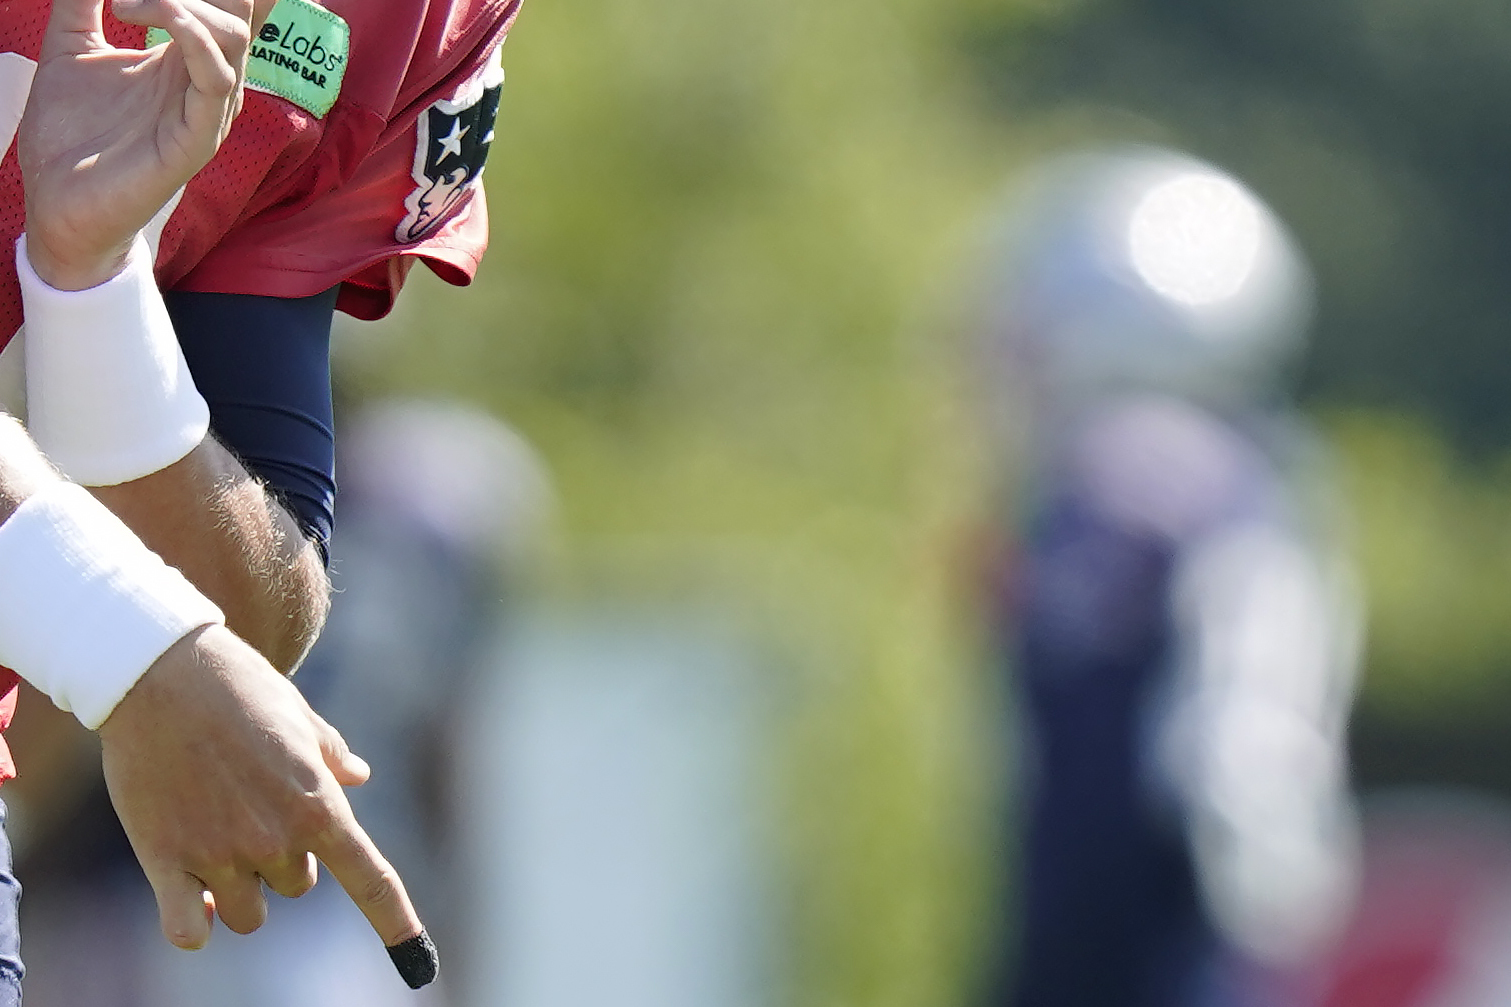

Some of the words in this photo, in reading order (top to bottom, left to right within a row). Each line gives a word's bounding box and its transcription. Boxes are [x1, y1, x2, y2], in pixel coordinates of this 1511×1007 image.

[249, 45, 299, 73] IATING
[301, 66, 327, 89] BAR
[259, 21, 340, 72] eLabs
